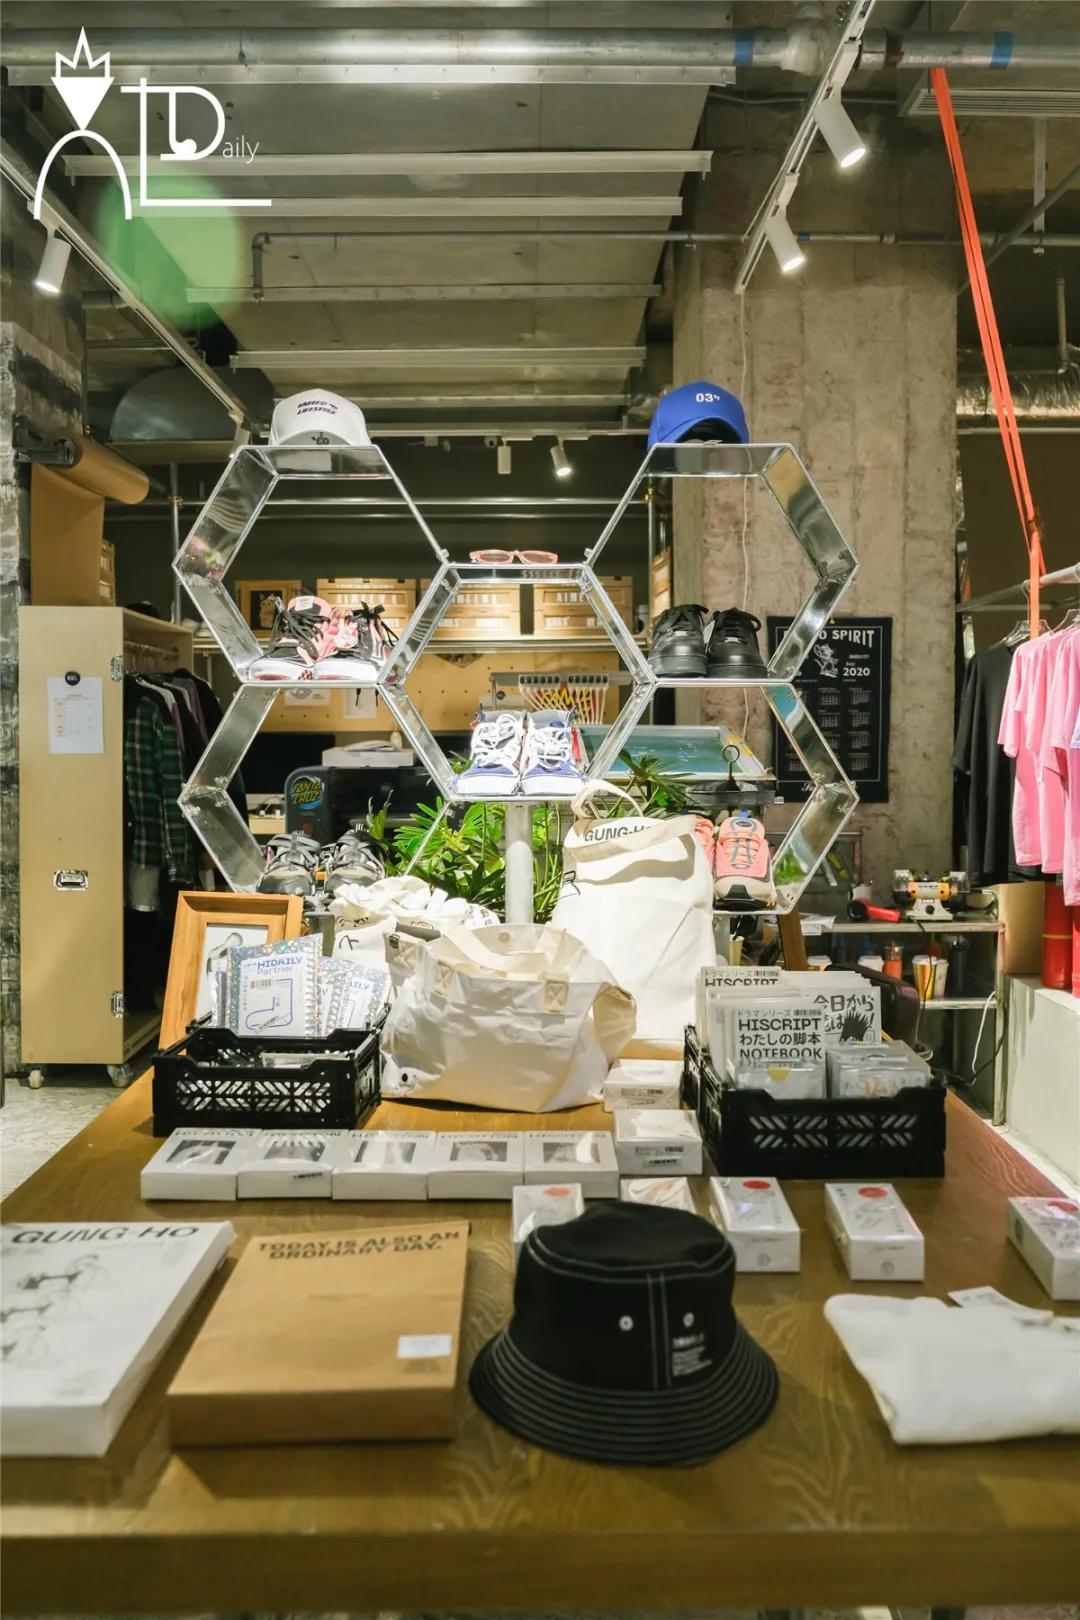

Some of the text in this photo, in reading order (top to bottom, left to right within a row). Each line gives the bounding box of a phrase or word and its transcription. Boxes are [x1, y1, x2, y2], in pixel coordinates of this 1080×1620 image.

[832, 630, 875, 648] SPIRIT
[842, 667, 871, 677] 2020
[257, 956, 303, 969] HIDAILY
[739, 1018, 822, 1032] HISCRIPT
[740, 1033, 822, 1047] わたしの脚本
[740, 1047, 823, 1060] NOTEBOOK
[259, 1231, 460, 1251] TODAY IS ALSO AN
[269, 1246, 385, 1260] ORDINARY
